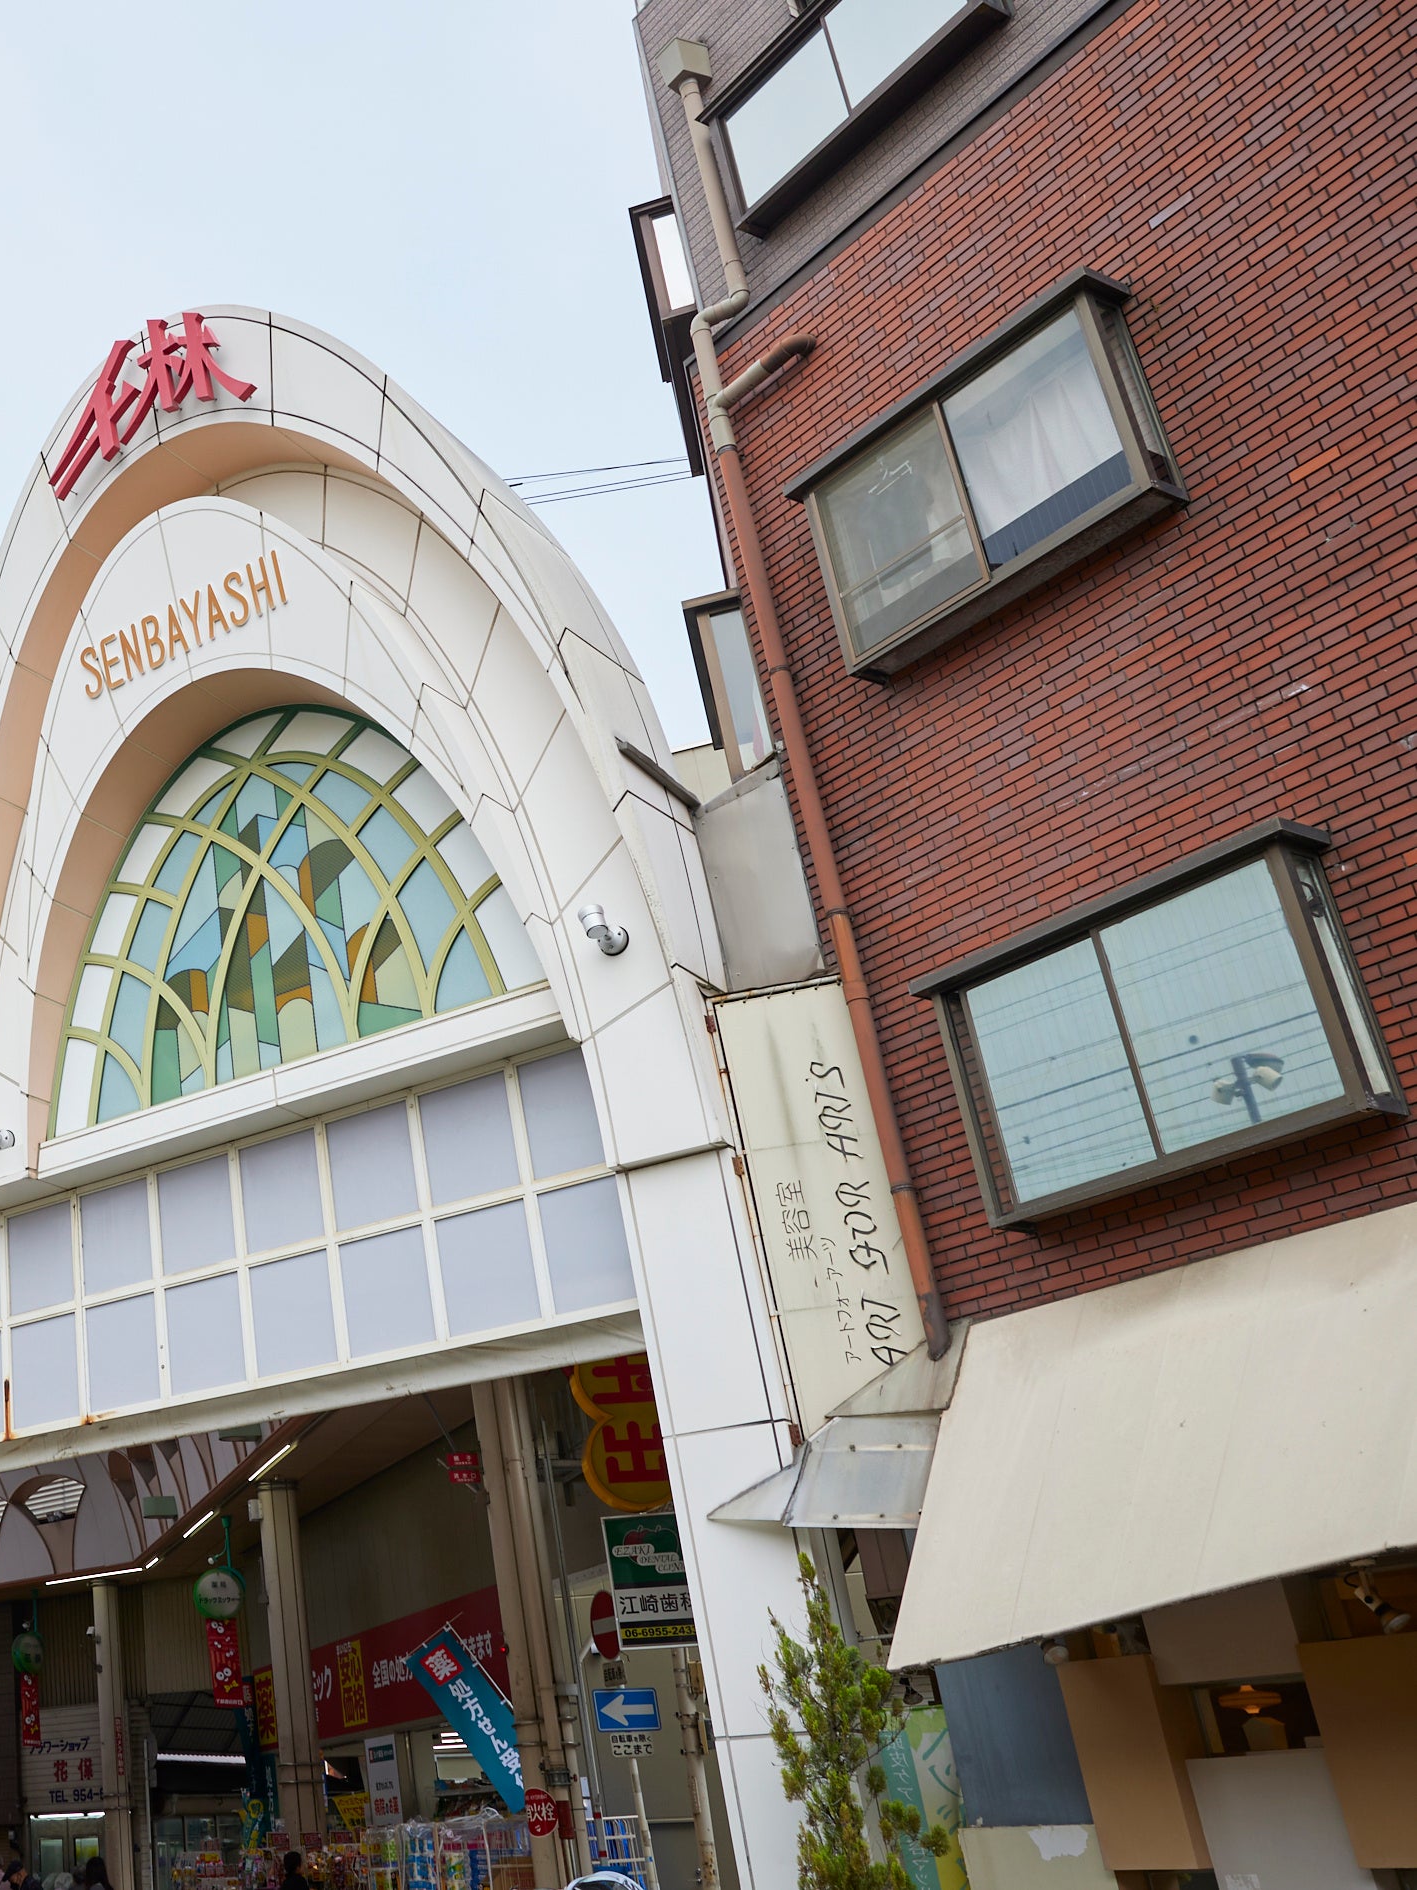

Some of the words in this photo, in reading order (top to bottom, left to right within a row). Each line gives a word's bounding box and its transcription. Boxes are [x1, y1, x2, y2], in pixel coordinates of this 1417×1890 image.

[80, 550, 288, 700] SENBAYASHI
[805, 1061, 865, 1162] ART'S
[776, 1179, 819, 1261] 美容室
[834, 1180, 890, 1275] FOR
[820, 1236, 862, 1364] アートフォーアーツ
[861, 1290, 909, 1367] ART
[615, 1544, 651, 1557] EZAKI
[639, 1555, 676, 1565] DENTAL
[425, 1648, 458, 1681] 薬
[611, 1734, 652, 1743] 自転車を除く
[613, 1744, 653, 1756] ここまで
[49, 1790, 68, 1804] TEL
